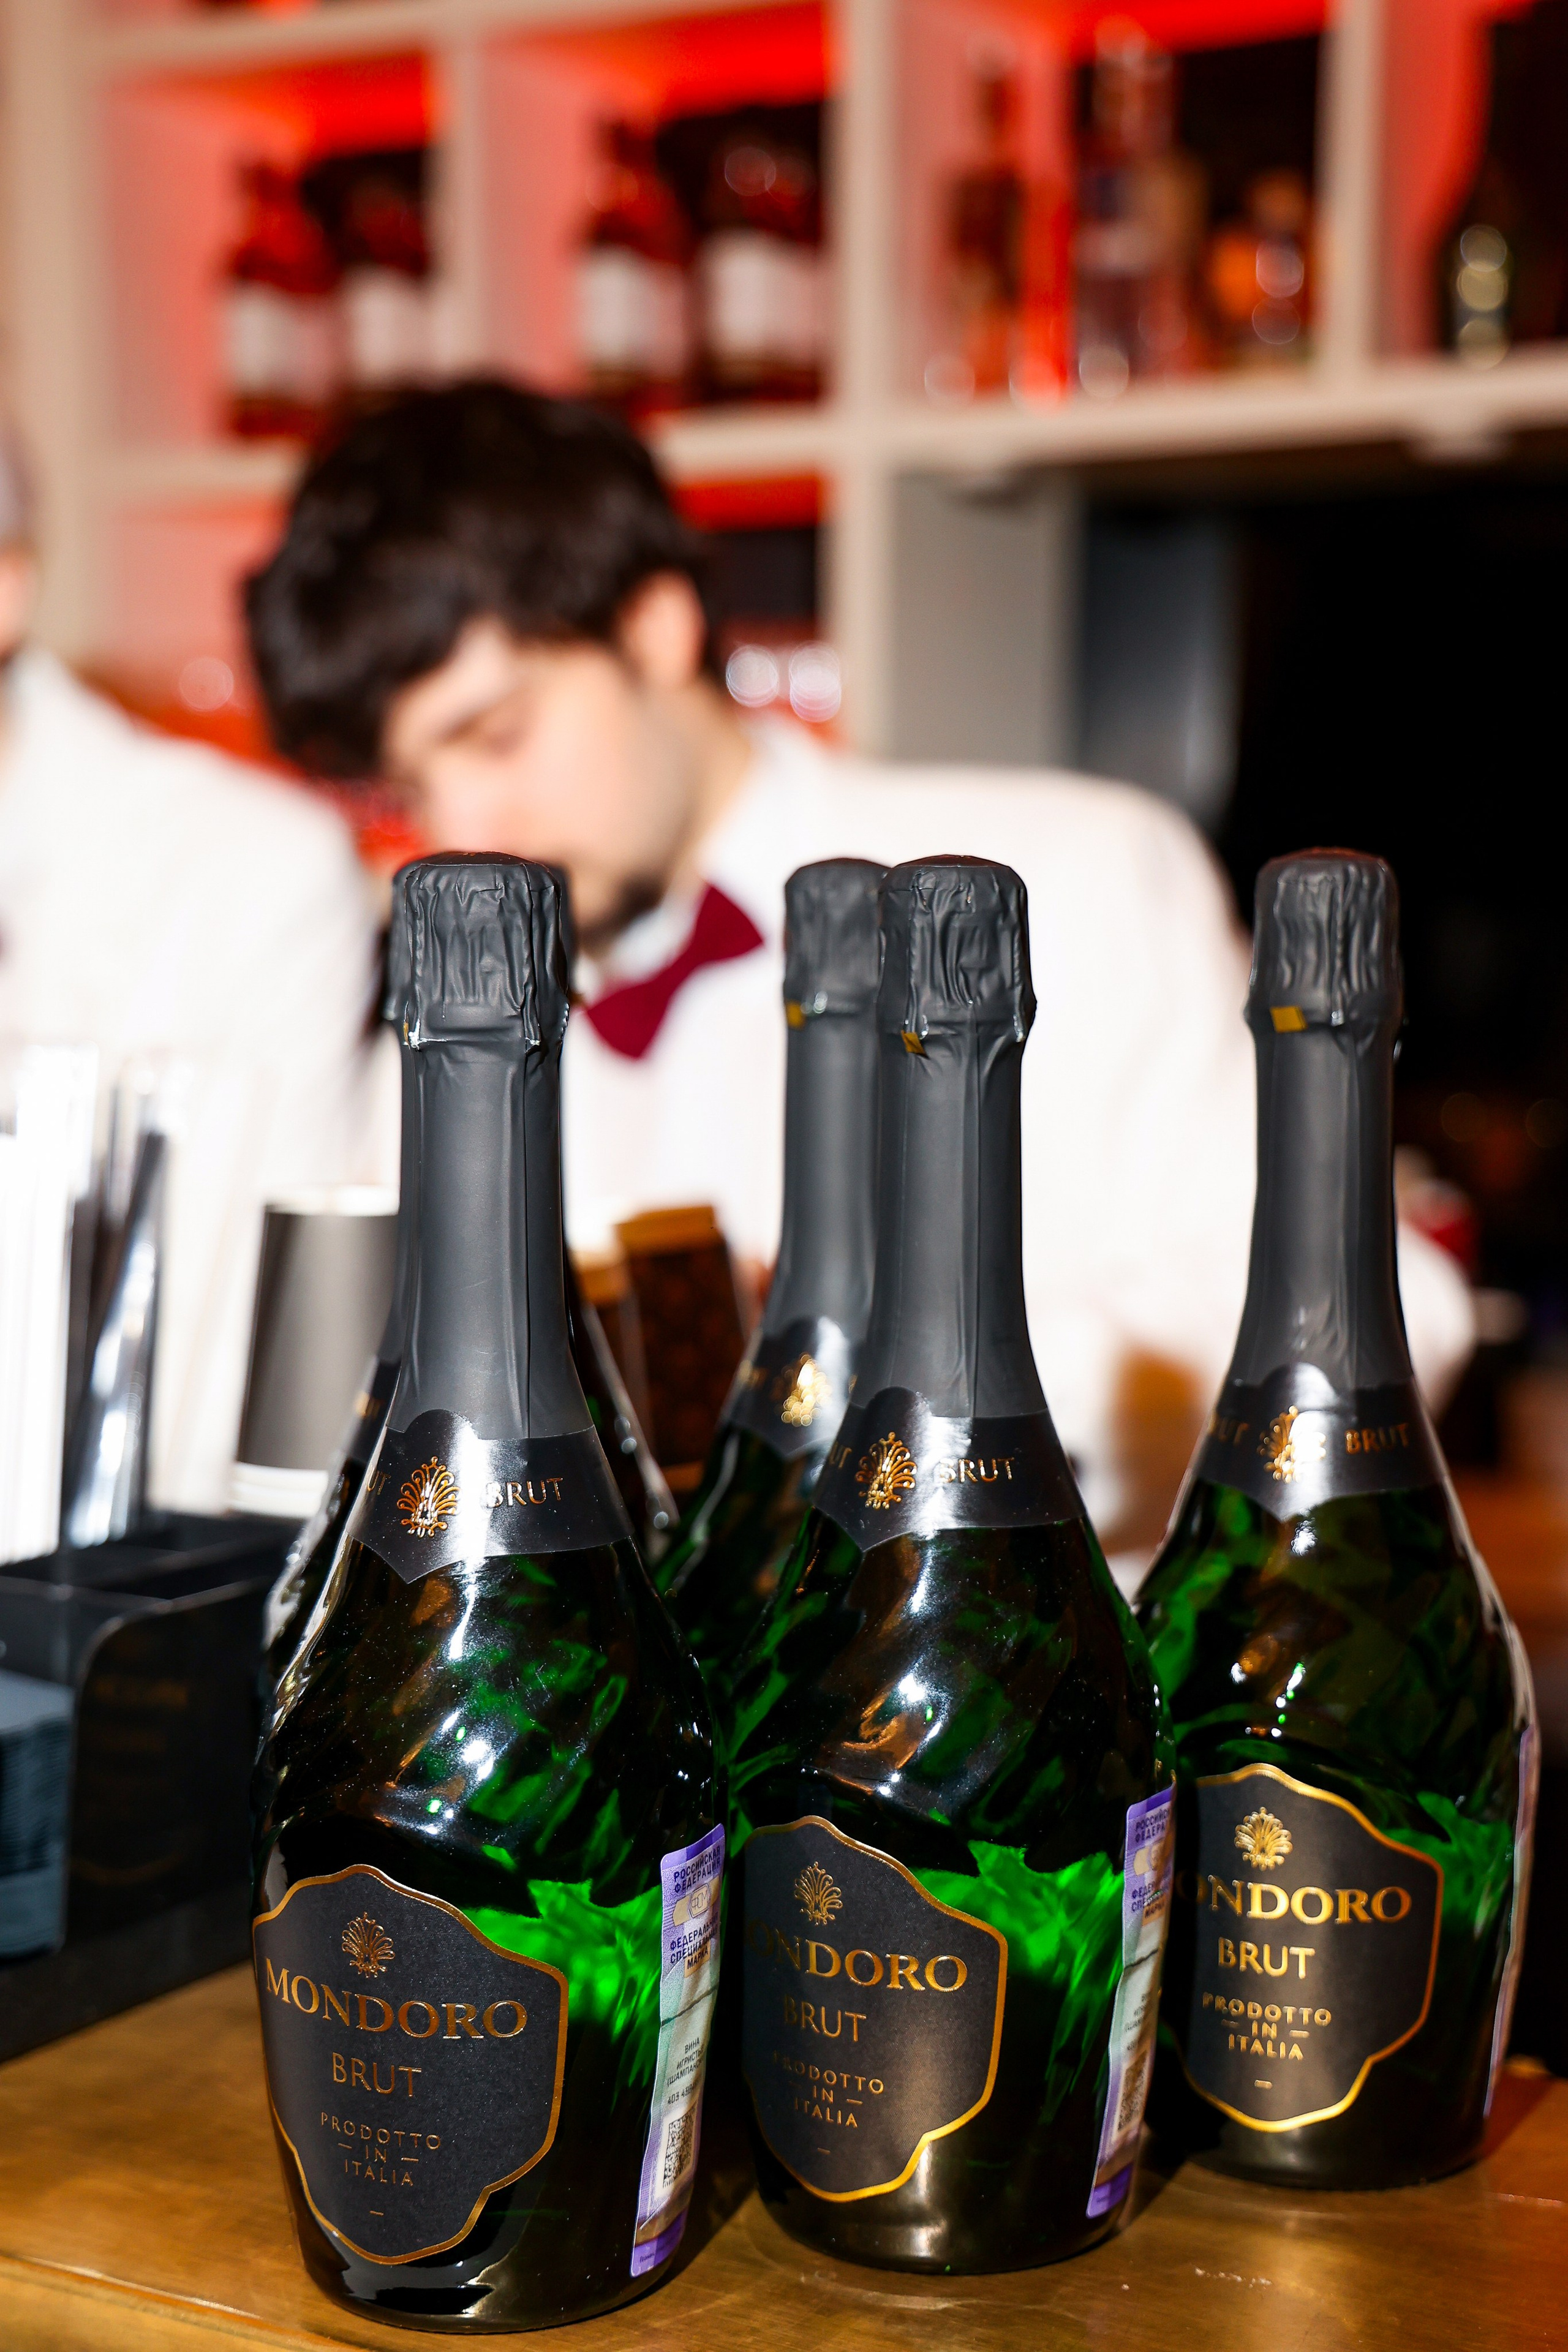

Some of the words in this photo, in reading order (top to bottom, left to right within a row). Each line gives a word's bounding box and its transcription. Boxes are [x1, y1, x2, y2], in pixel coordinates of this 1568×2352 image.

[1344, 1422, 1409, 1455] BRUT
[938, 1457, 1015, 1484] BRUT
[485, 1477, 564, 1509] BRUT
[673, 1845, 721, 1882] РОССИЙСКАЯ
[674, 1856, 721, 1893] ФЕДЕРАЦИЯ
[1174, 1868, 1412, 1924] ONDORO
[687, 1945, 709, 1970] МАРКА
[744, 1919, 970, 1993] ONDORO
[1217, 1936, 1316, 1980] BRUT
[266, 1957, 529, 2040] MONDORO
[1202, 1991, 1332, 2026] PRODOTTO
[784, 1994, 867, 2042] BRUT
[1251, 2019, 1278, 2040] IN
[684, 2037, 700, 2054] ВИНА
[1227, 2033, 1304, 2061] ITALIA
[332, 2051, 423, 2098] BRUT
[812, 2084, 834, 2104] IN
[795, 2098, 859, 2129] ITALIA
[320, 2111, 442, 2150] PRODOTTO
[364, 2145, 388, 2165] IN
[344, 2159, 415, 2187] ITALIA
